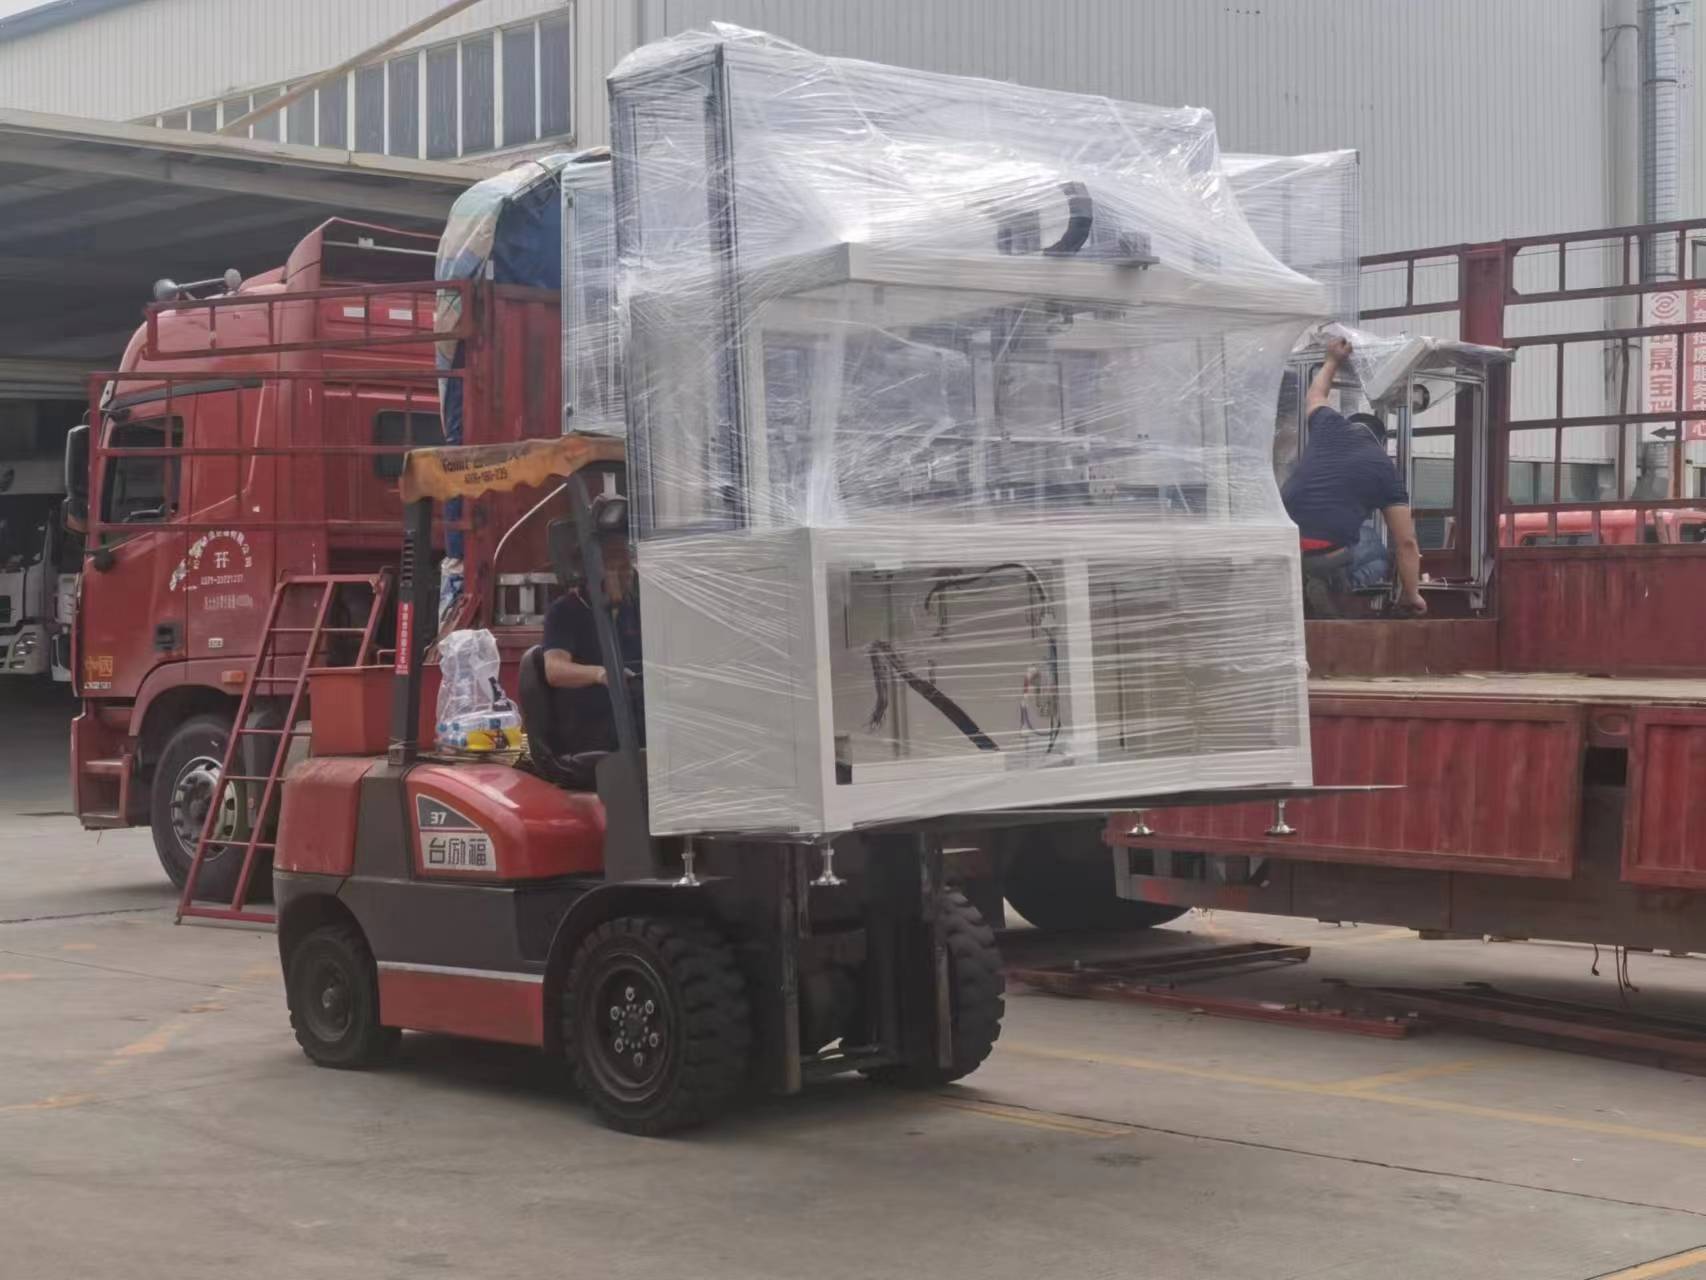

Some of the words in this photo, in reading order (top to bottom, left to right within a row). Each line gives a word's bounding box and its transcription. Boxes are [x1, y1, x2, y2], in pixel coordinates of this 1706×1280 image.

[430, 811, 447, 825] 37
[428, 837, 488, 866] 台励福
